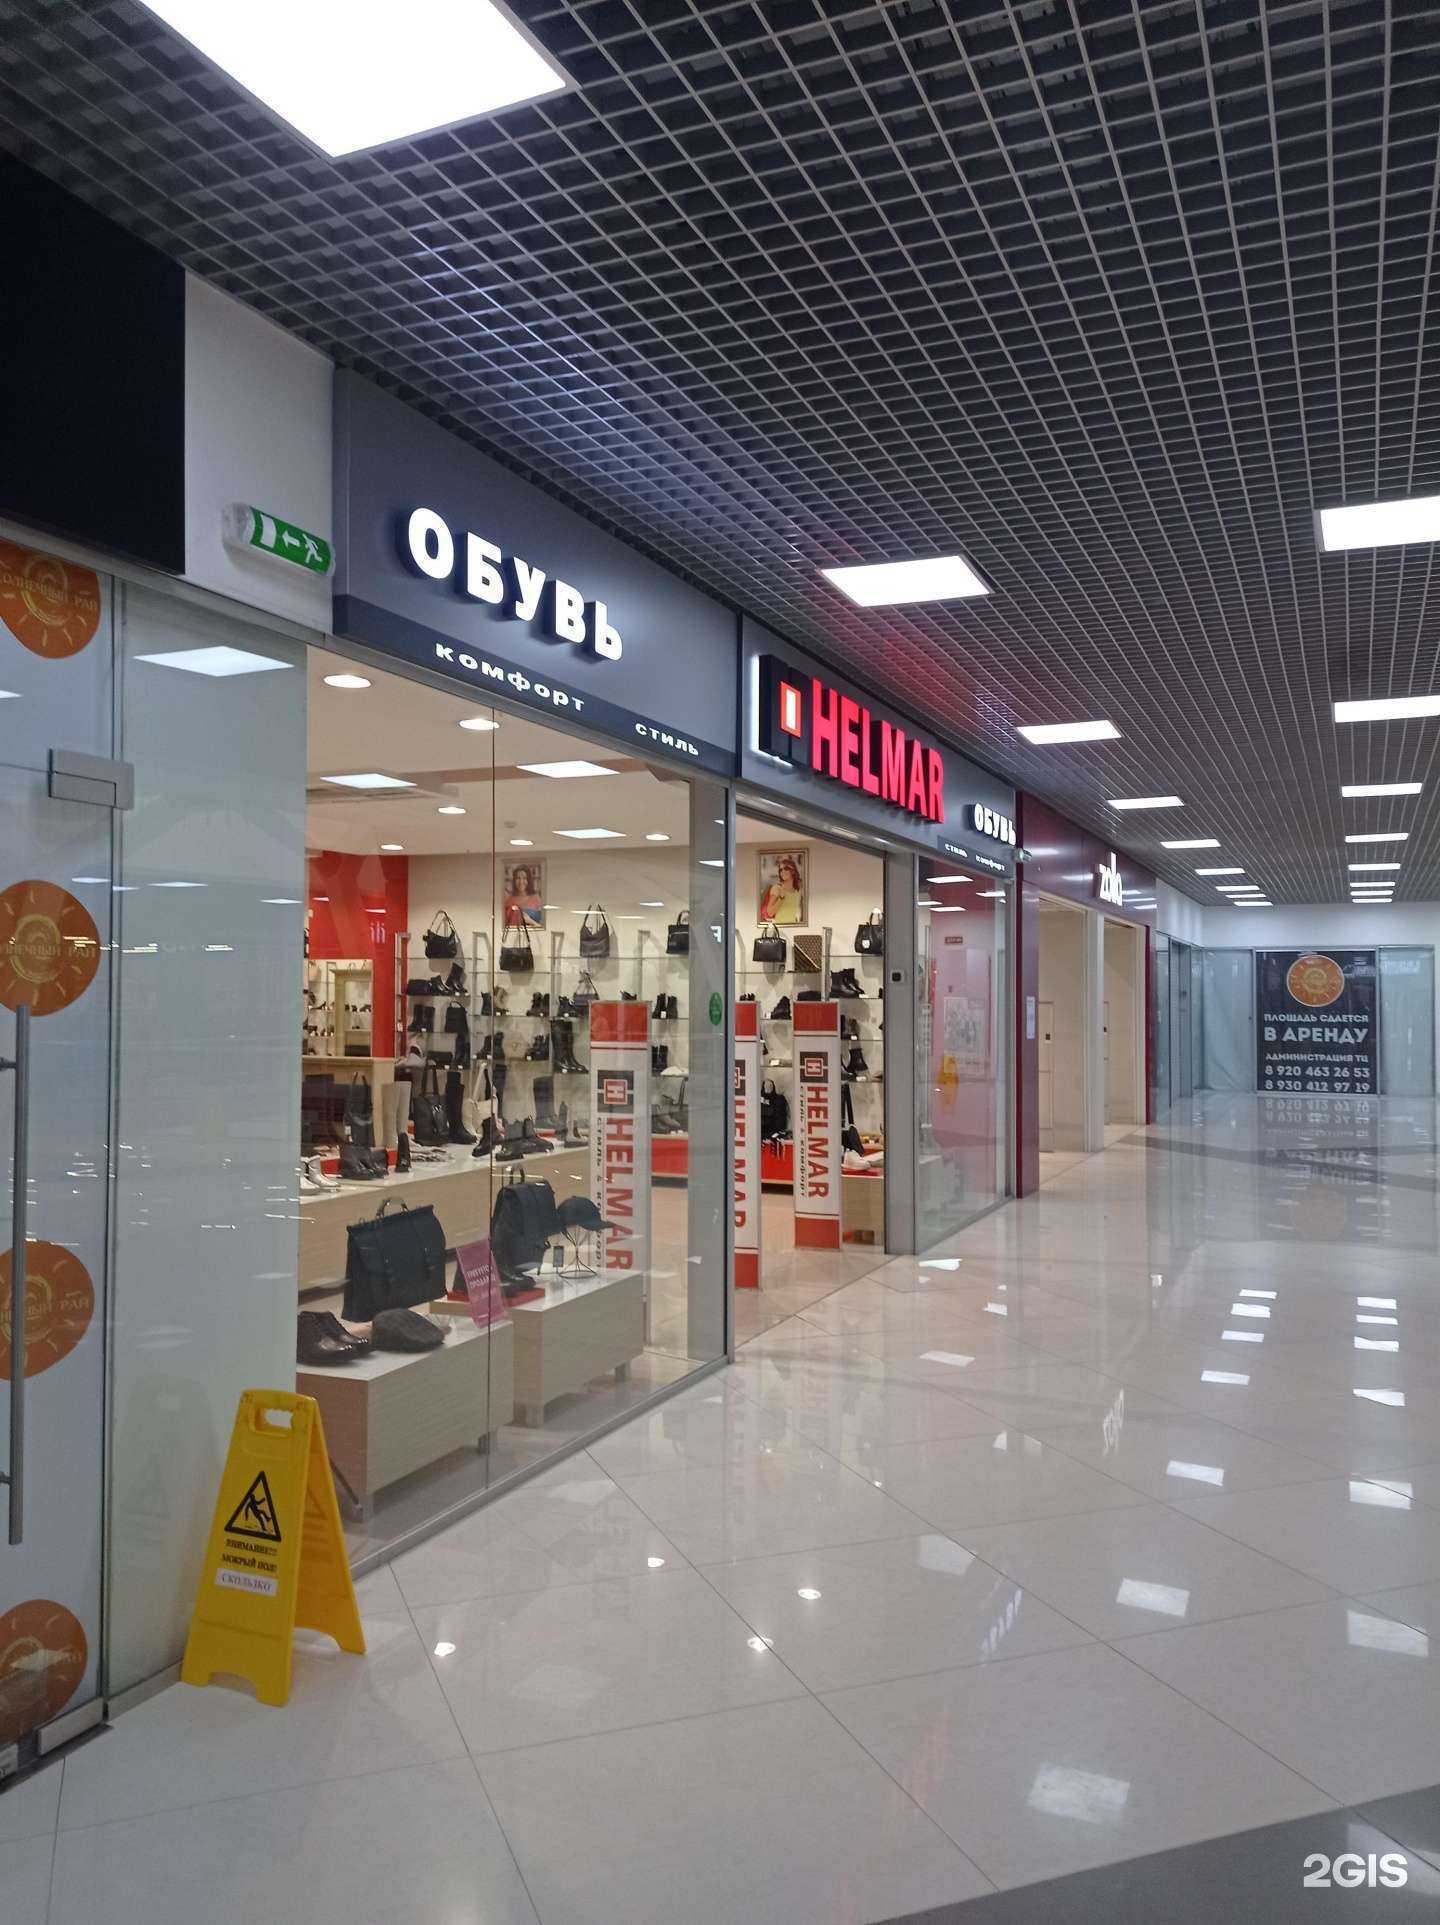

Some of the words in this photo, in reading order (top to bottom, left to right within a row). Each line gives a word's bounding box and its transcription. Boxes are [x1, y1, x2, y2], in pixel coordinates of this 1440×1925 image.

[408, 507, 623, 661] ОБУВЬ
[811, 677, 946, 824] HELMAR
[974, 803, 1017, 846] ОБУВЬ
[1264, 1013, 1318, 1023] ПЛОЩАДЬ
[1320, 1014, 1369, 1023] СДАЕТСЯ
[1264, 1026, 1277, 1041] В
[1281, 1027, 1369, 1044] АРЕНДУ
[1264, 1065, 1274, 1076] 8
[1276, 1065, 1302, 1077] 920
[1305, 1066, 1330, 1077] 463
[1333, 1067, 1350, 1078] 26
[1353, 1068, 1370, 1078] 53
[1265, 1053, 1354, 1063] АДМИНИСТРАЦИЯ
[1355, 1054, 1369, 1063] ТЦ
[1265, 1080, 1274, 1090] 8
[1276, 1080, 1302, 1091] 930
[1305, 1081, 1329, 1092] 412
[1334, 1082, 1350, 1093] 97
[1355, 1083, 1370, 1093] 19
[807, 1086, 829, 1198] HELMAR
[606, 1118, 634, 1270] HELMAR
